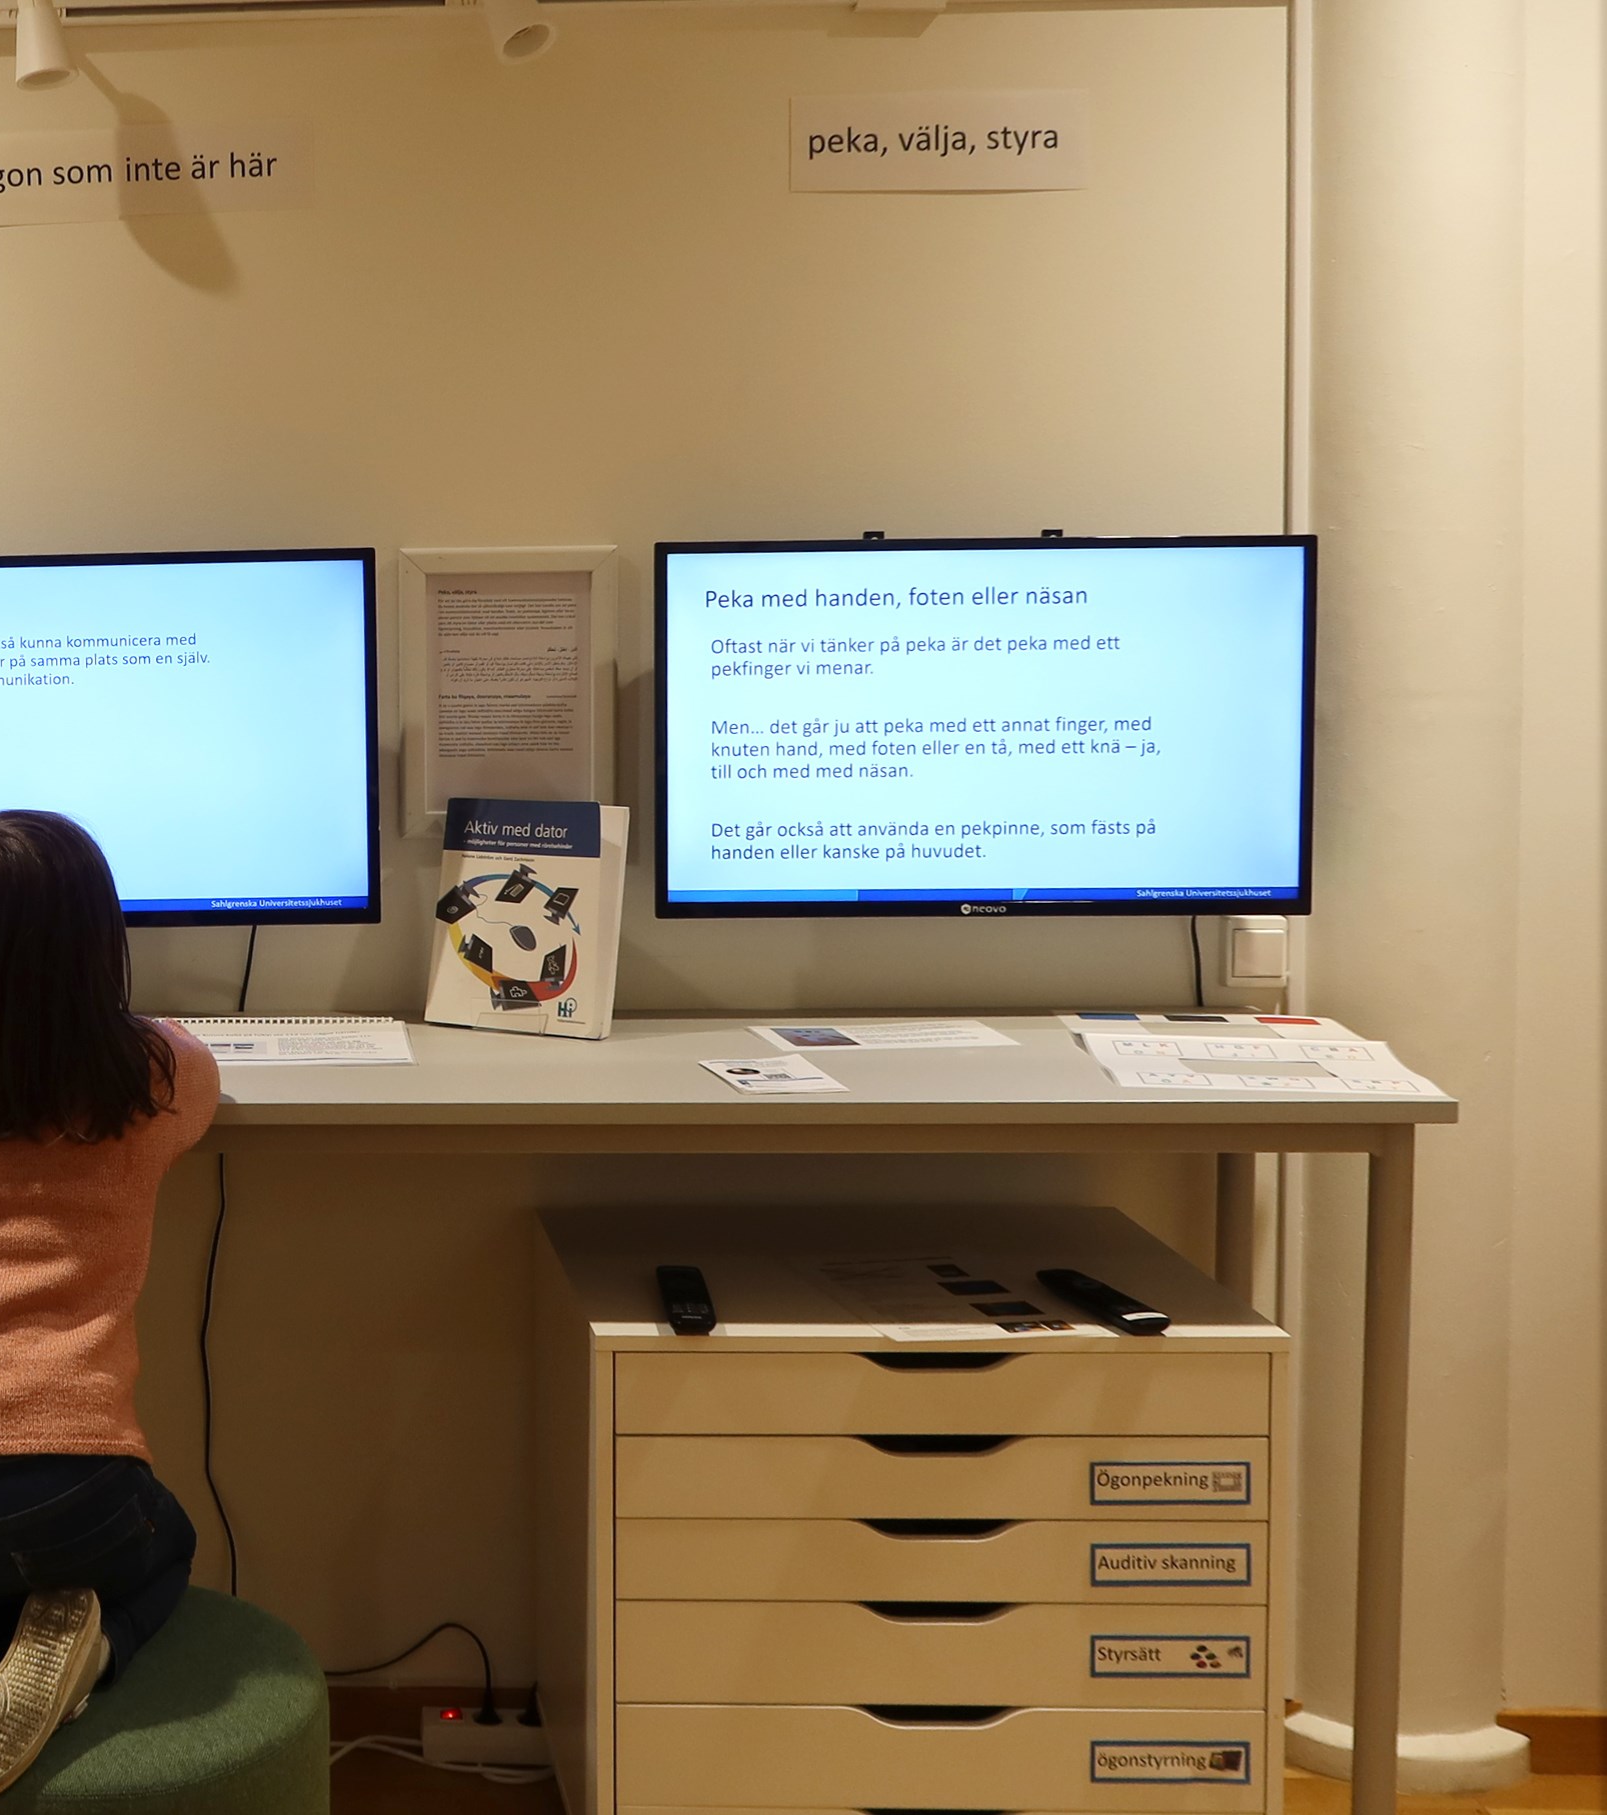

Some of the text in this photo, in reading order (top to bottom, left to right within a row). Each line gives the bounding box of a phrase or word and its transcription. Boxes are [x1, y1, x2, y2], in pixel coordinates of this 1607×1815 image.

[809, 124, 1058, 160] peka, välja, styra
[53, 164, 112, 185] som
[126, 157, 180, 182] inte
[192, 155, 220, 179] är
[230, 152, 277, 178] här
[706, 587, 1087, 609] Peka med handen, foten eller näsan
[20, 636, 61, 649] kunna
[67, 635, 161, 648] kommunicera
[166, 633, 196, 645] med
[711, 635, 1120, 655] Oftast när vi tänker på peka är det peka med ett
[10, 655, 26, 670] på
[31, 657, 80, 667] samma
[85, 653, 118, 668] plats
[122, 655, 151, 665] som
[156, 655, 172, 664] en
[177, 651, 210, 667] själv.
[712, 660, 873, 680] pekfinger vi menar.
[712, 716, 1151, 737] Men... det går ju att peka med ett annat finger, med
[712, 742, 769, 757] knuten
[776, 741, 823, 758] hand,
[829, 741, 866, 756] med
[872, 740, 916, 756] foten
[922, 740, 960, 755] eller
[965, 743, 985, 755] en
[991, 738, 1012, 756] tå,
[1019, 739, 1055, 754] med
[1061, 741, 1085, 754] ett
[1091, 739, 1120, 754] knä
[1140, 739, 1160, 757] ja,
[711, 763, 913, 779] till och med med näsan.
[464, 820, 568, 838] Aktiv med dator
[712, 818, 1156, 841] Det går också att använda en pekpinne, som fästs på
[712, 843, 986, 862] handen eller kanske på huvudet.
[1136, 889, 1272, 898] Sahlgrenska Universitetssjukhuset
[211, 899, 342, 909] Sahlgrenska Universitetssjukhuset
[972, 905, 1007, 914] neovo
[1097, 1472, 1209, 1490] Ögonpekning
[1098, 1555, 1236, 1573] Auditiv skanning
[1098, 1647, 1161, 1664] Styrsätt
[1097, 1753, 1206, 1771] ögonstyrning
